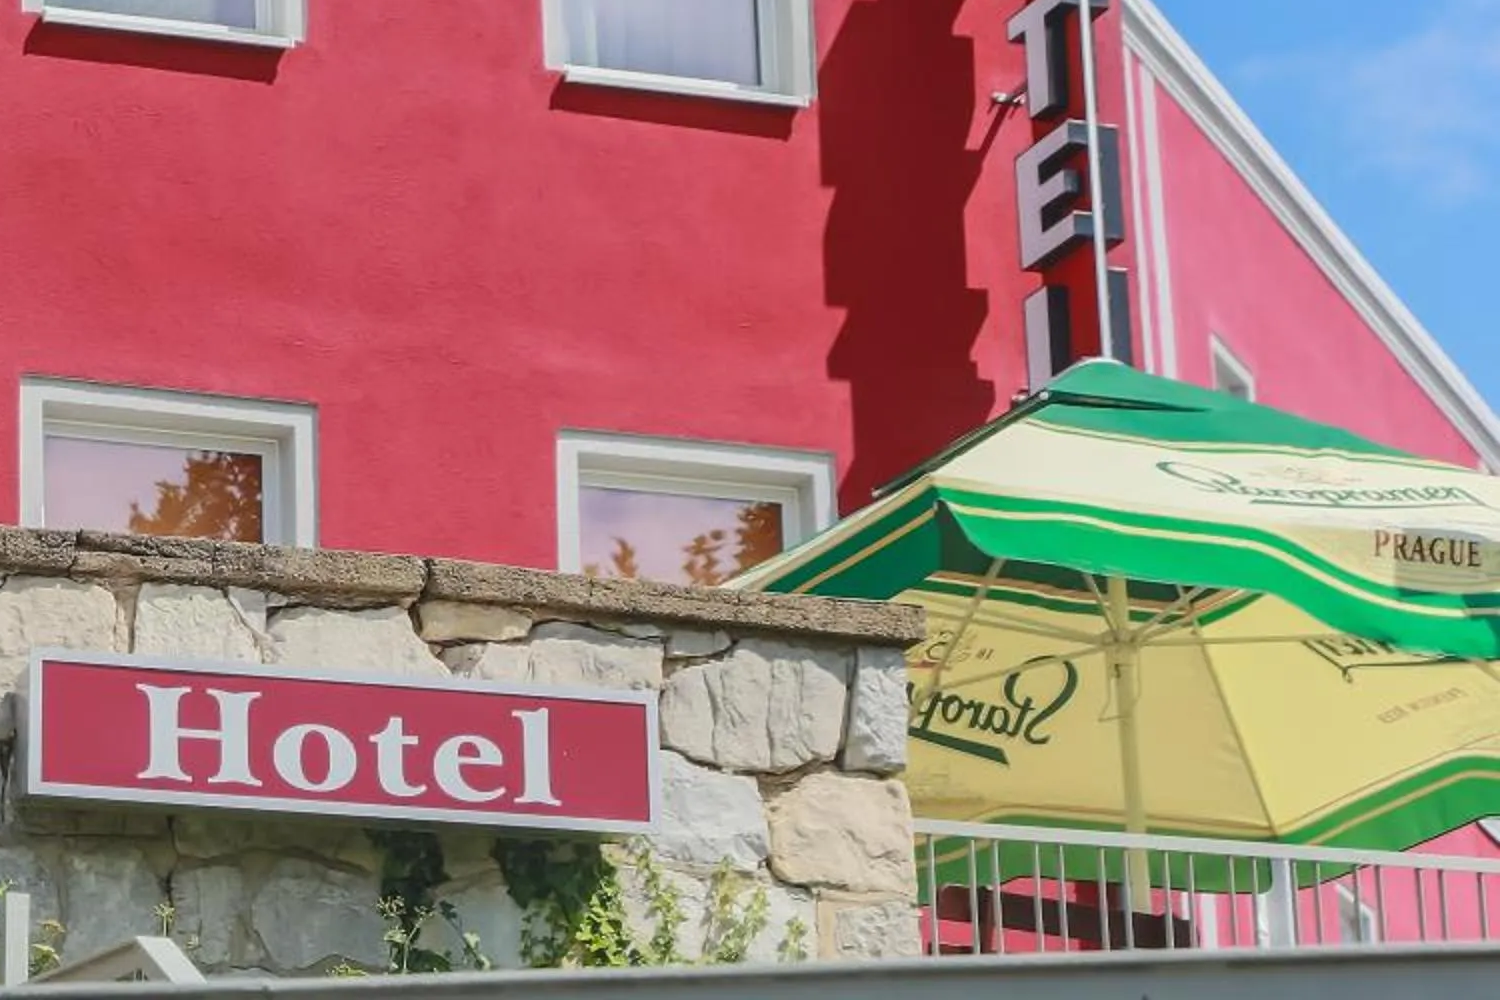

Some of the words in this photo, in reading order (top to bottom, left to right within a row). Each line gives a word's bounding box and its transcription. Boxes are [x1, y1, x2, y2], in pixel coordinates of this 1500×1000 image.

[1155, 460, 1490, 508] Staropramen
[1373, 528, 1482, 568] PRAGUE
[135, 683, 562, 807] Hotel
